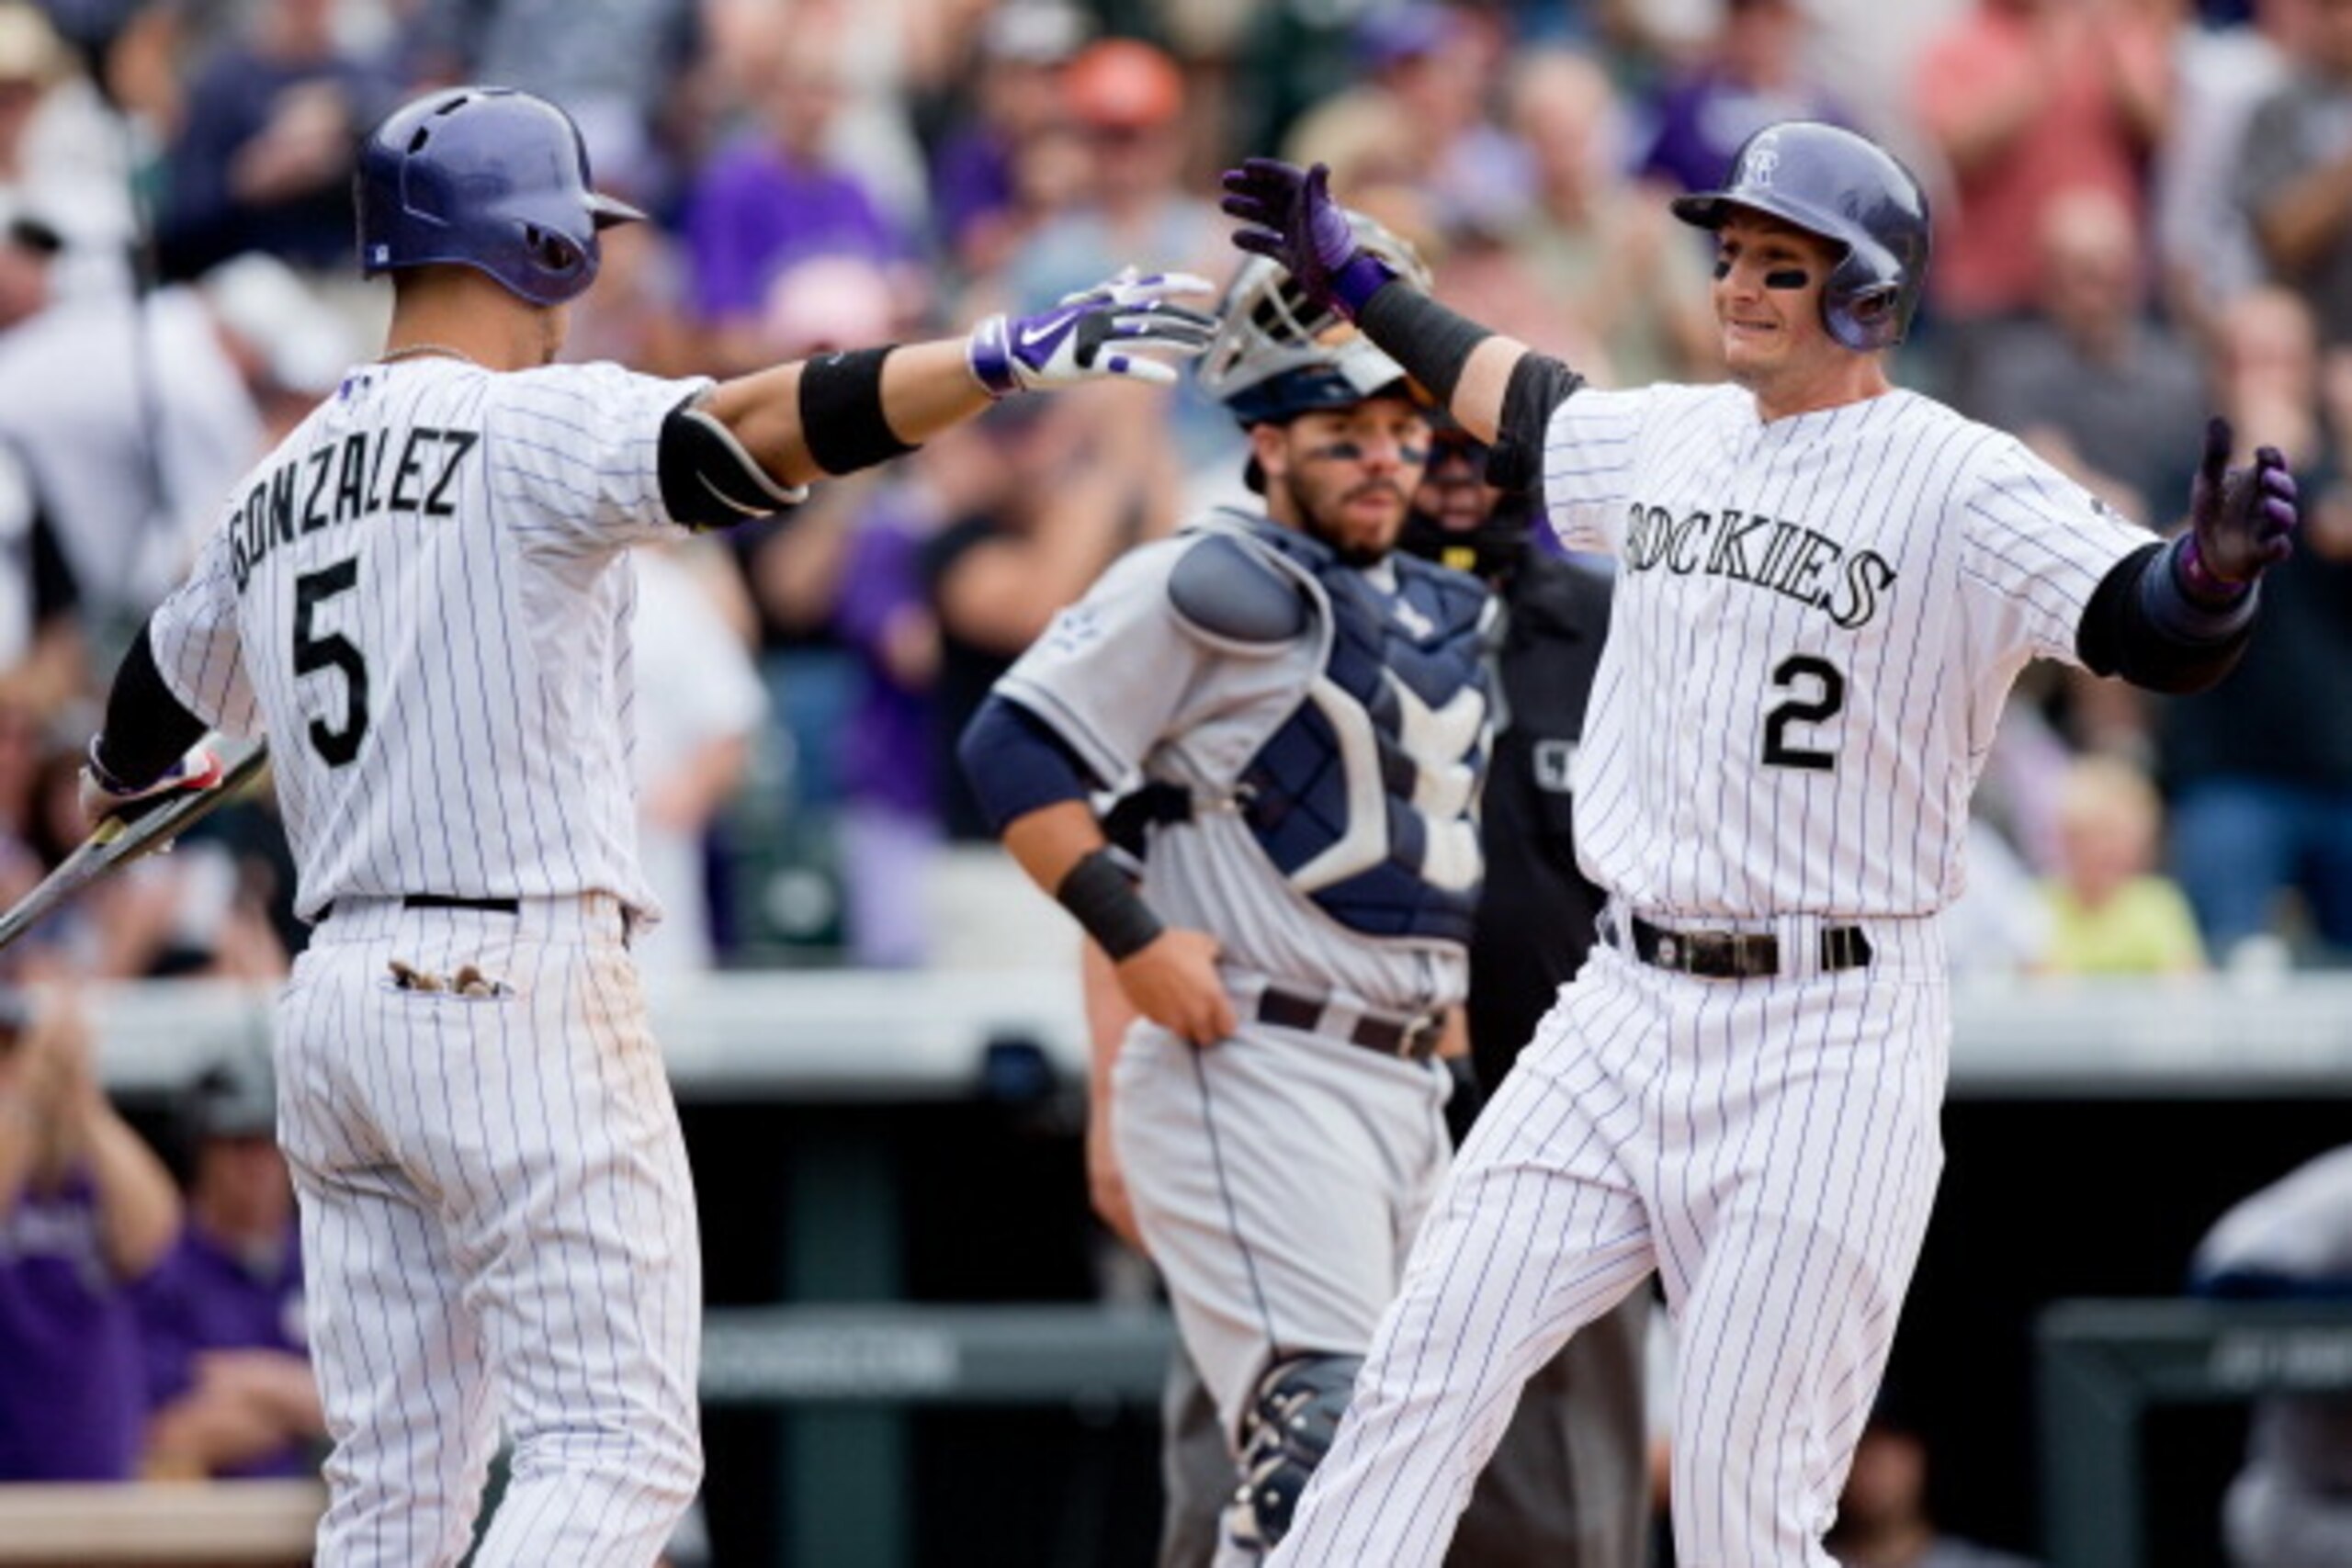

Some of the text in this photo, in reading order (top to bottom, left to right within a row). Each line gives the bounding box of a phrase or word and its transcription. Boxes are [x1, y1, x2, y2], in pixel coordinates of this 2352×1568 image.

[230, 427, 479, 594] GONZALEZ
[293, 556, 368, 769] 5
[1761, 653, 1845, 772] 2
